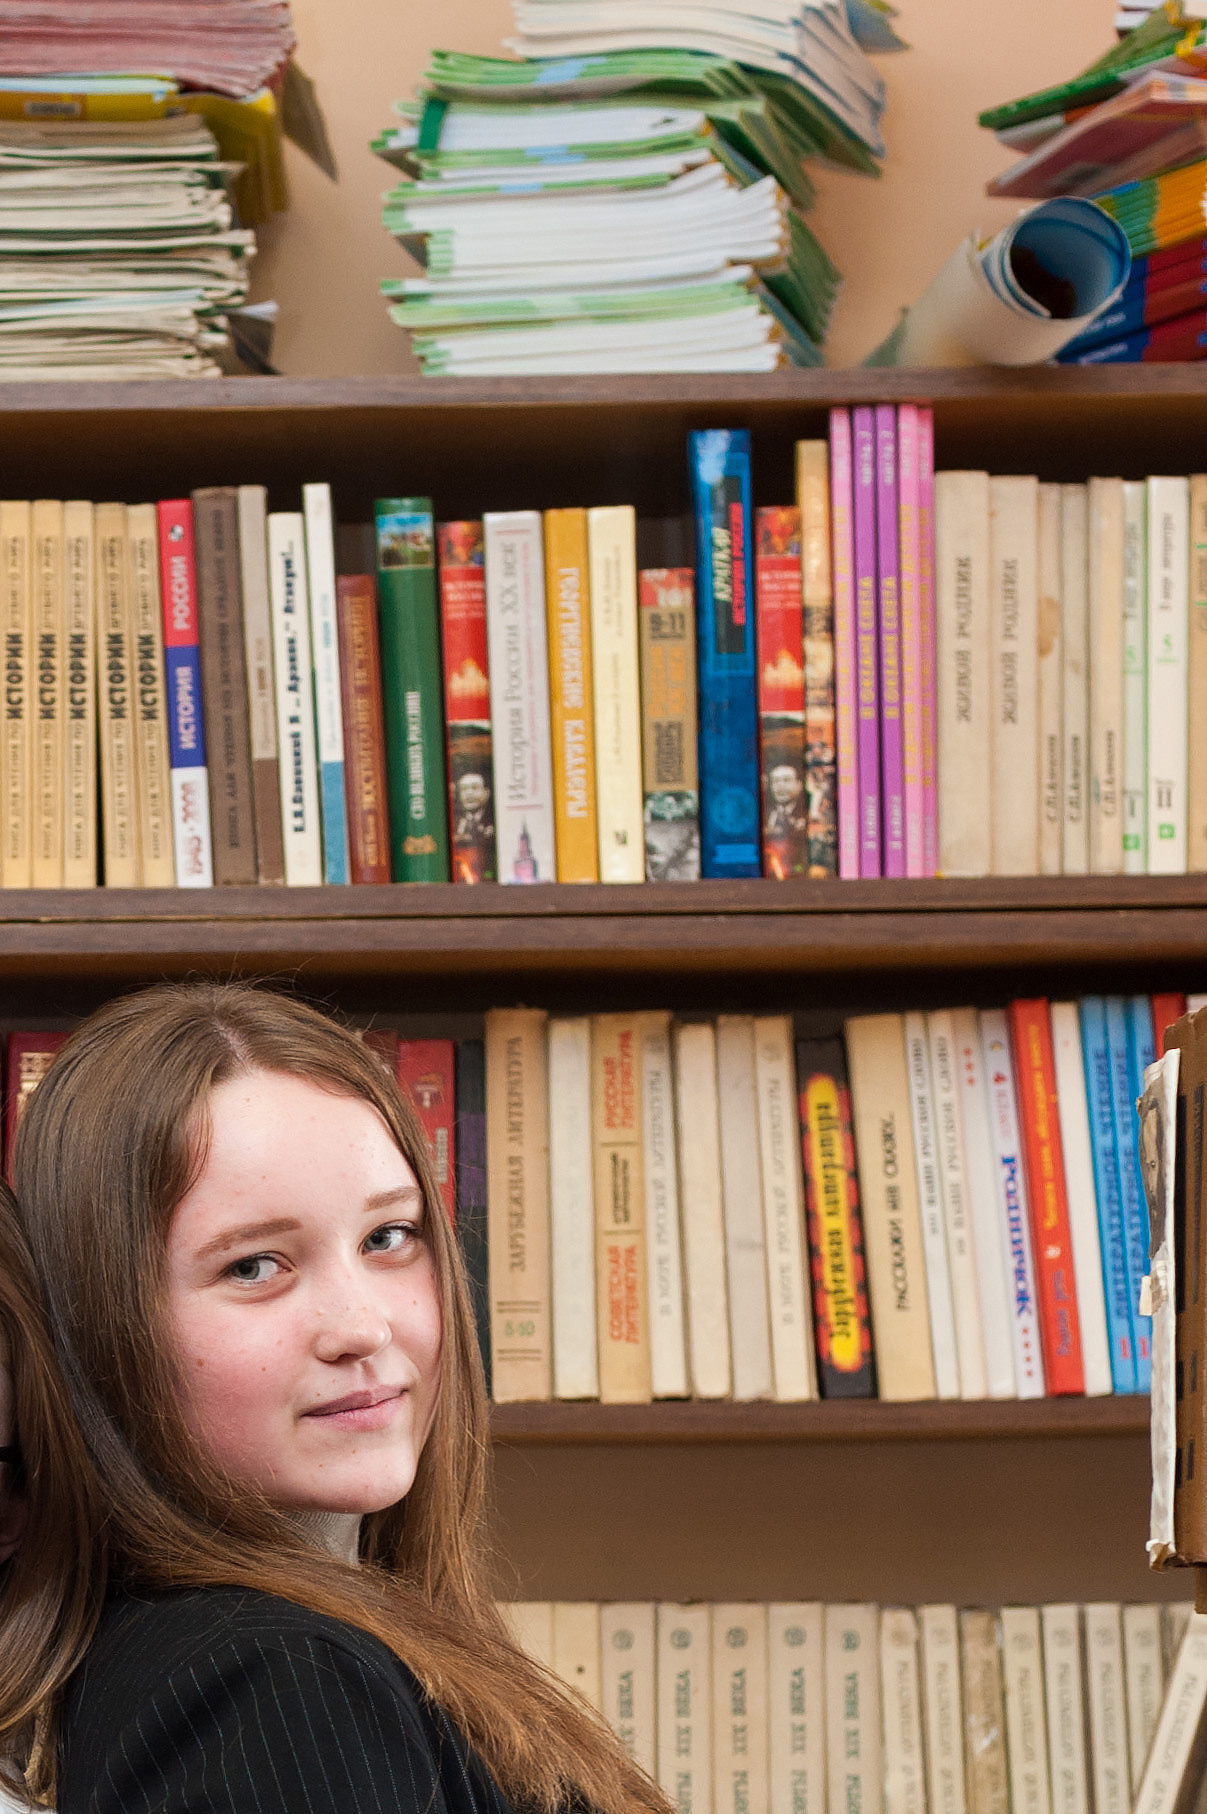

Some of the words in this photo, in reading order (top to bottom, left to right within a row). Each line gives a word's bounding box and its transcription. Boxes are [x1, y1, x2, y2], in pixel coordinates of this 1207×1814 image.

[169, 554, 191, 631] РОССИИ
[497, 583, 520, 615] XX
[498, 541, 518, 578] век
[955, 555, 973, 639] РОДНИК
[999, 557, 1018, 641] РОДНИК
[6, 632, 24, 719] ИСТОРИИ
[37, 632, 55, 719] ИСТОРИИ
[68, 632, 86, 719] ИСТОРИИ
[106, 632, 127, 719] ИСТОРИИ
[137, 632, 159, 720] ИСТОРИИ
[497, 623, 525, 703] России
[557, 567, 585, 709] ГЕОРГИЕВСКИЕ
[174, 664, 197, 749] ИСТОРИЯ
[955, 649, 972, 723] ЖИВОЙ
[1000, 651, 1018, 725] ЖИВОЙ
[502, 706, 533, 801] История
[564, 719, 588, 820] КАВАЛЕРЫ
[505, 1036, 524, 1147] ЛИТЕРАТУРА
[602, 1055, 617, 1128] РУССКАЯ
[617, 1030, 634, 1129] ЛИТЕРАТУРА
[507, 1155, 527, 1272] ЗАРУБЕЖНАЯ
[606, 1245, 622, 1341] СОВЕТСКАЯ
[622, 1245, 639, 1344] ЛИТЕРАТУРА
